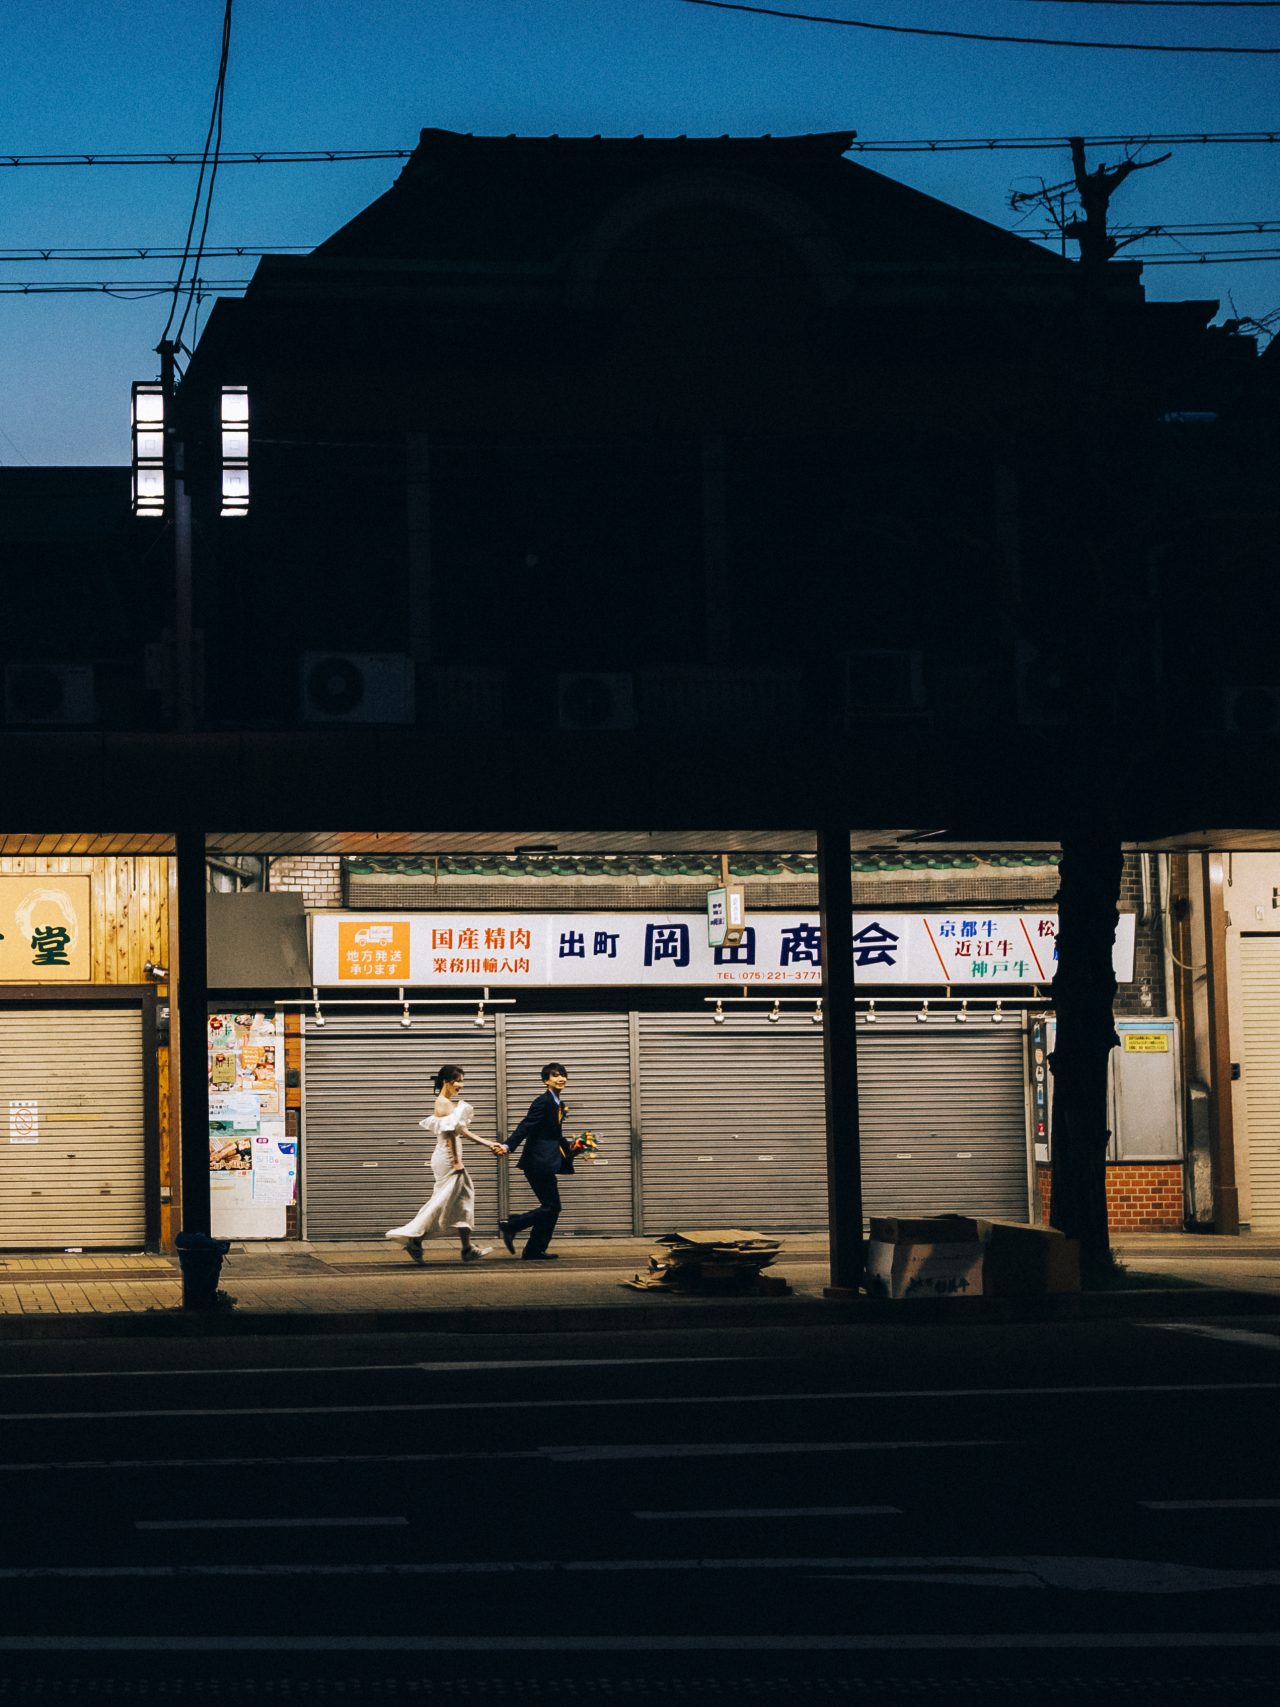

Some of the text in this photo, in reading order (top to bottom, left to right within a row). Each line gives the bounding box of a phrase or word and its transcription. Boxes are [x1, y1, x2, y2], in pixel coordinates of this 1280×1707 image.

[939, 919, 998, 938] 京都牛
[432, 927, 531, 949] 国産精肉
[558, 921, 900, 967] 出町 岡田商会
[346, 949, 402, 962] 地方発送
[955, 940, 1014, 957] 近江牛
[350, 963, 398, 975] 承ります
[433, 957, 530, 973] 業務用輸入肉
[971, 960, 1030, 978] 神戸牛
[717, 972, 735, 980] TEL
